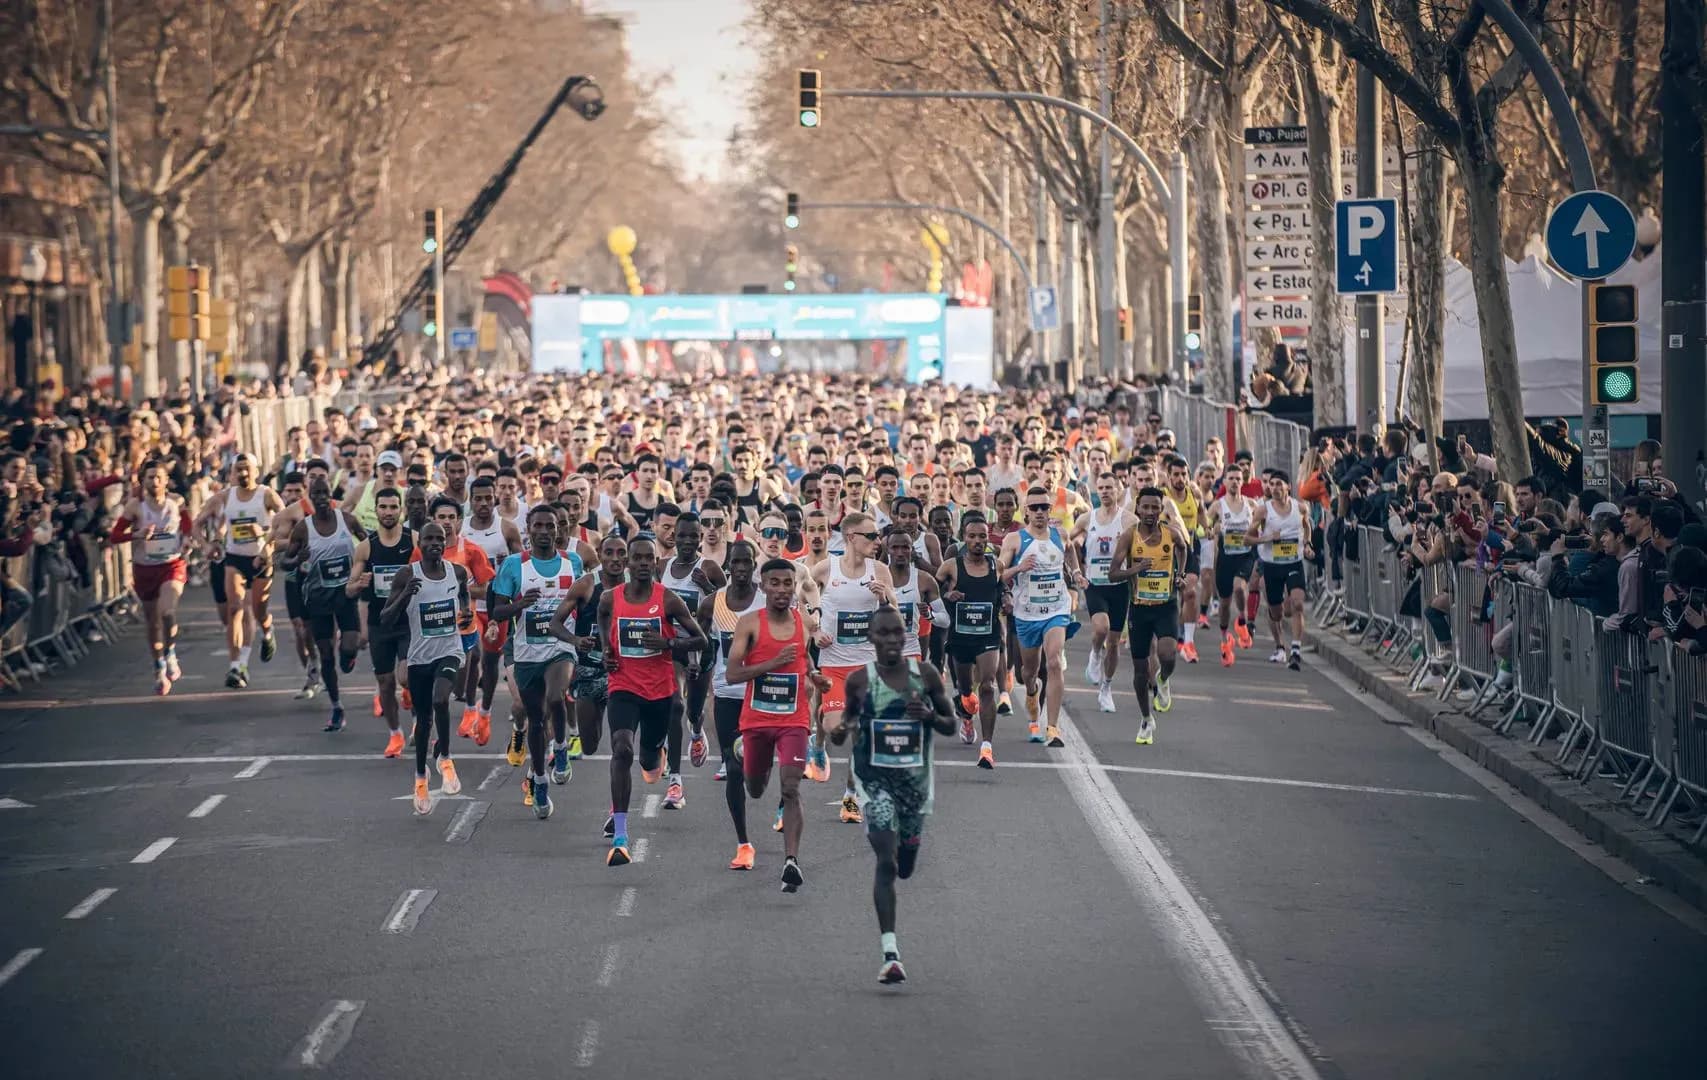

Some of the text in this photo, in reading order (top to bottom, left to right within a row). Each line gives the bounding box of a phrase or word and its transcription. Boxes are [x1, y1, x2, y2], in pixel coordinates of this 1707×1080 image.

[1258, 128, 1275, 142] Pg.
[1272, 151, 1296, 167] Av.
[1272, 182, 1290, 198] Pl.
[1272, 213, 1296, 232] Pg.
[1348, 206, 1385, 256] P
[1273, 243, 1300, 259] Arc
[1273, 304, 1308, 320] Rda.
[884, 735, 909, 746] PACER
